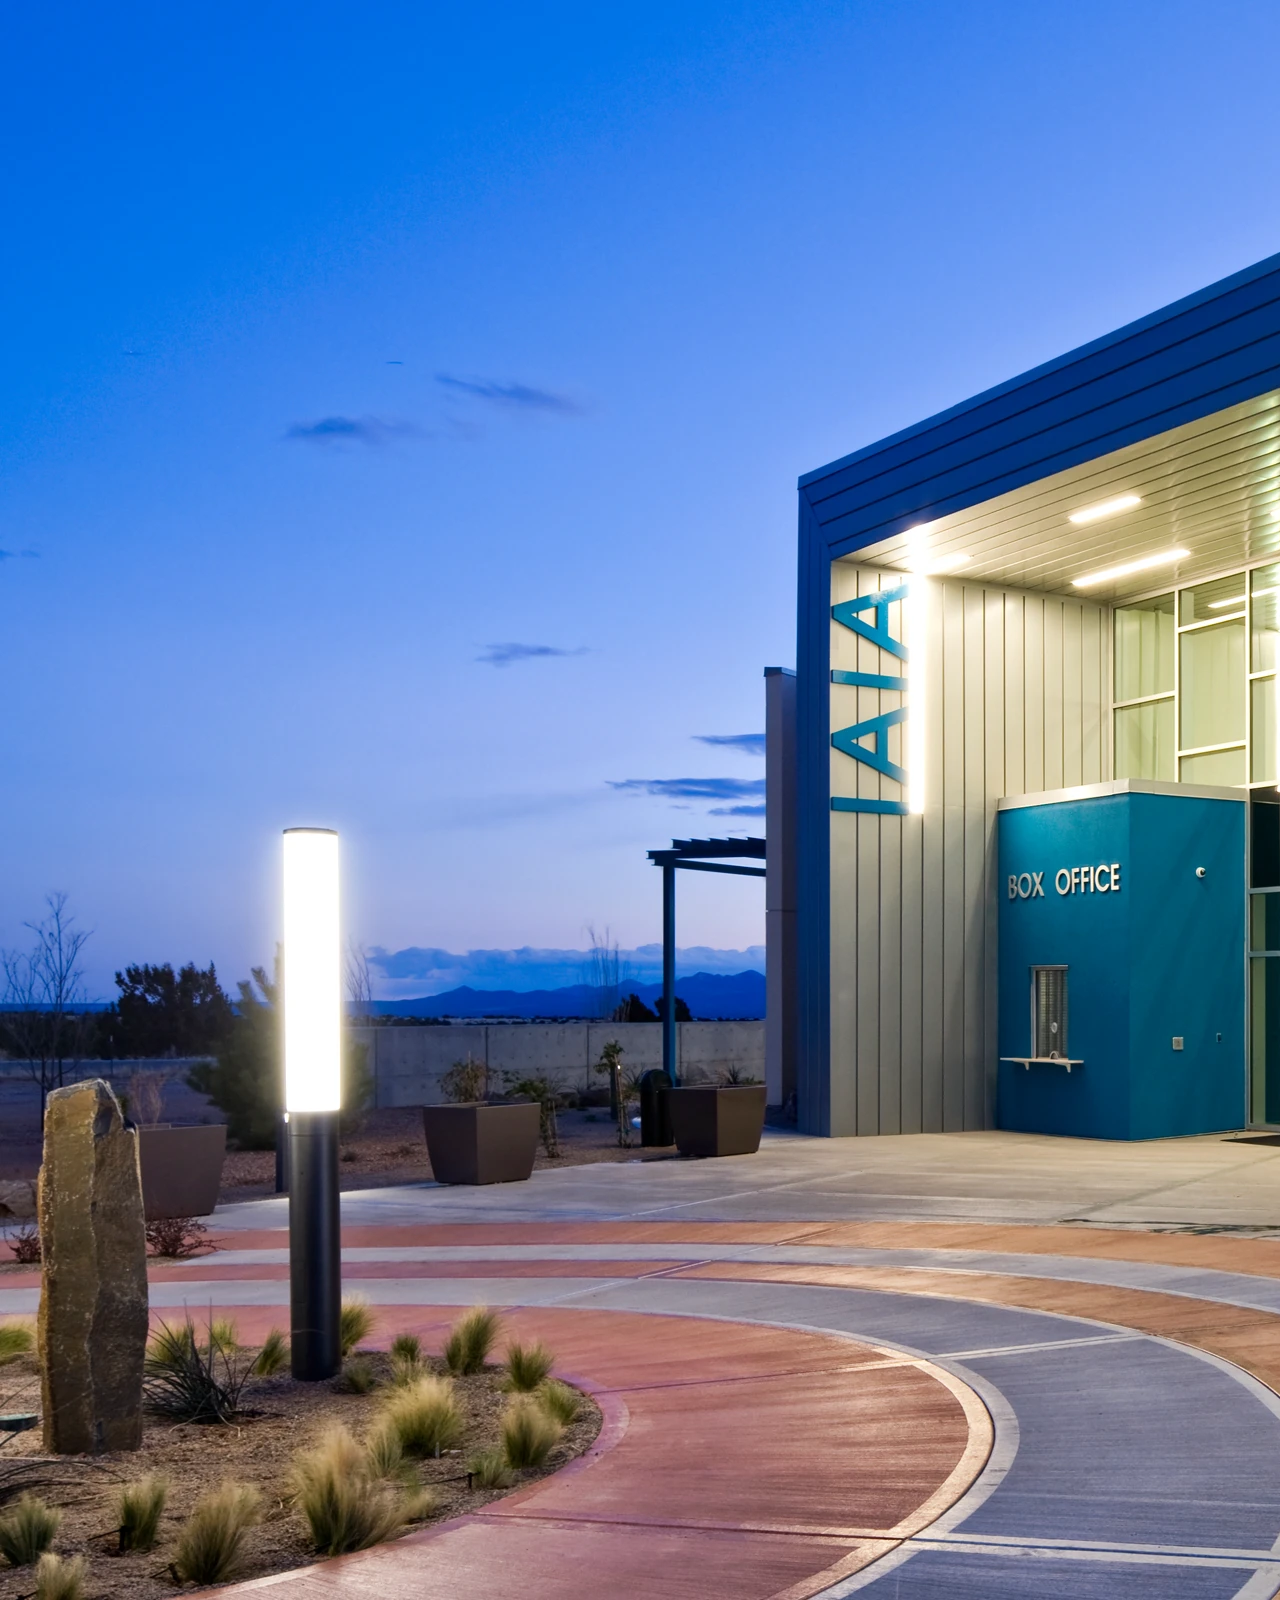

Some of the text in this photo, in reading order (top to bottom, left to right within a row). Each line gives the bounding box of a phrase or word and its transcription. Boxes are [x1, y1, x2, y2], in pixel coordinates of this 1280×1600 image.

[831, 583, 910, 815] IAIA
[1008, 863, 1120, 899] BOX OFFICE
